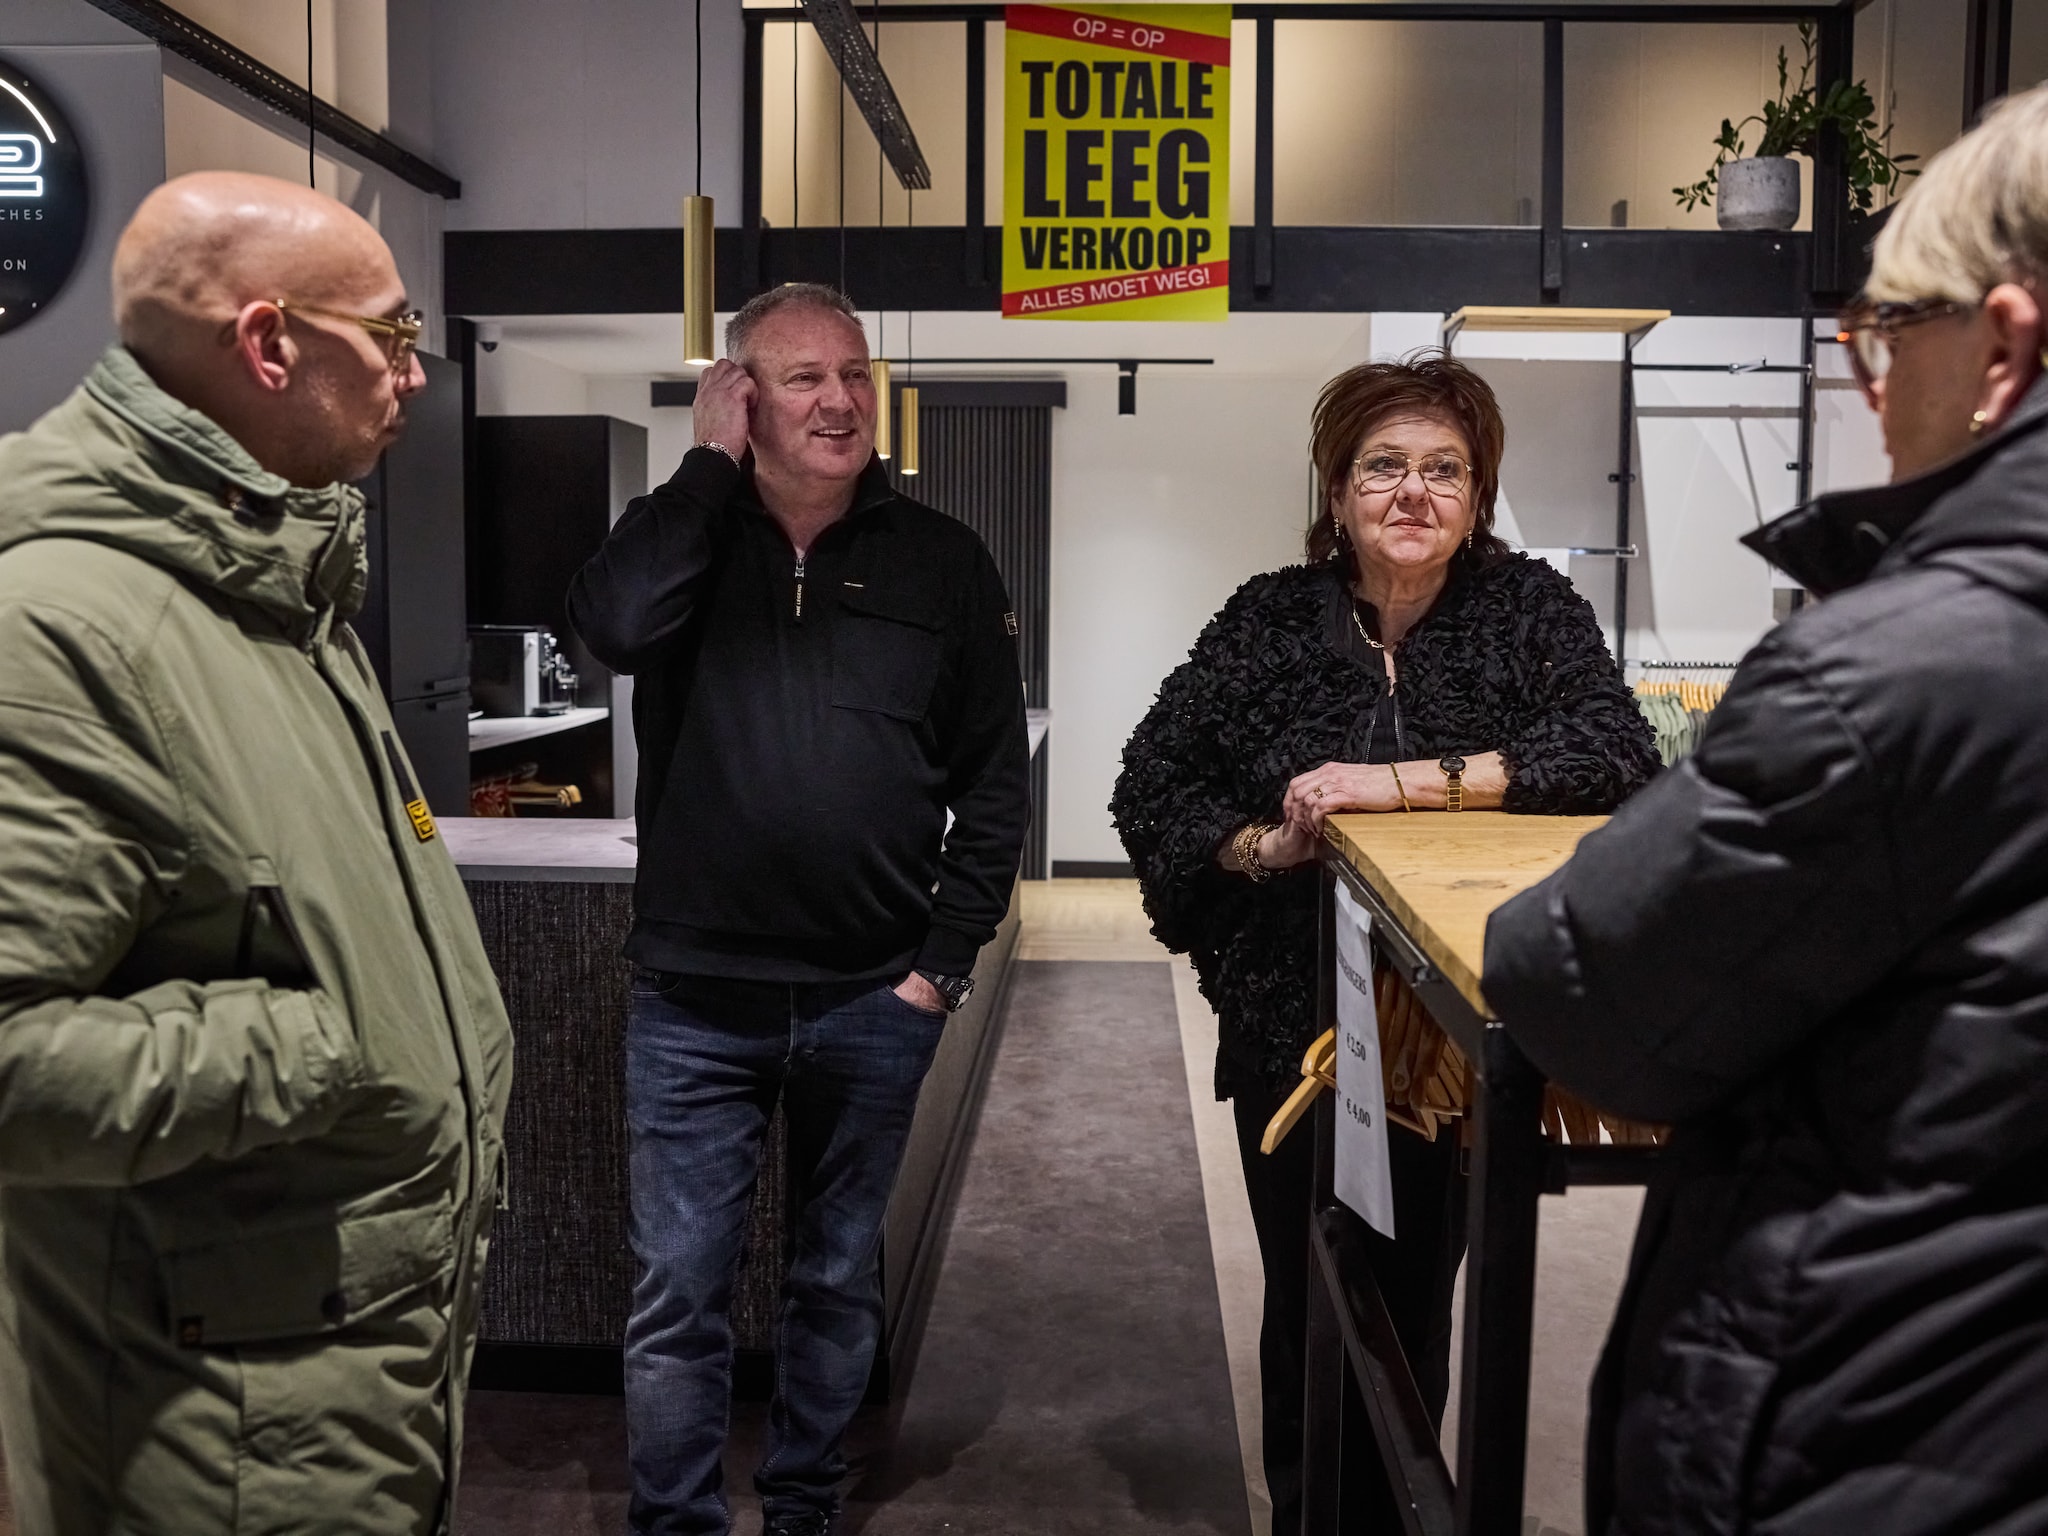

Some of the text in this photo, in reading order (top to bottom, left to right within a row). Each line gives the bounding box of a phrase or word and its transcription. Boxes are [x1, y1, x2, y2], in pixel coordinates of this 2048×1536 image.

[1073, 17, 1106, 38] OP
[1131, 27, 1165, 49] OP
[1021, 60, 1214, 120] TOTALE
[1023, 128, 1210, 220] LEEG
[1020, 226, 1211, 271] VERKOOP
[1020, 268, 1210, 311] ALLES MOET WEG!
